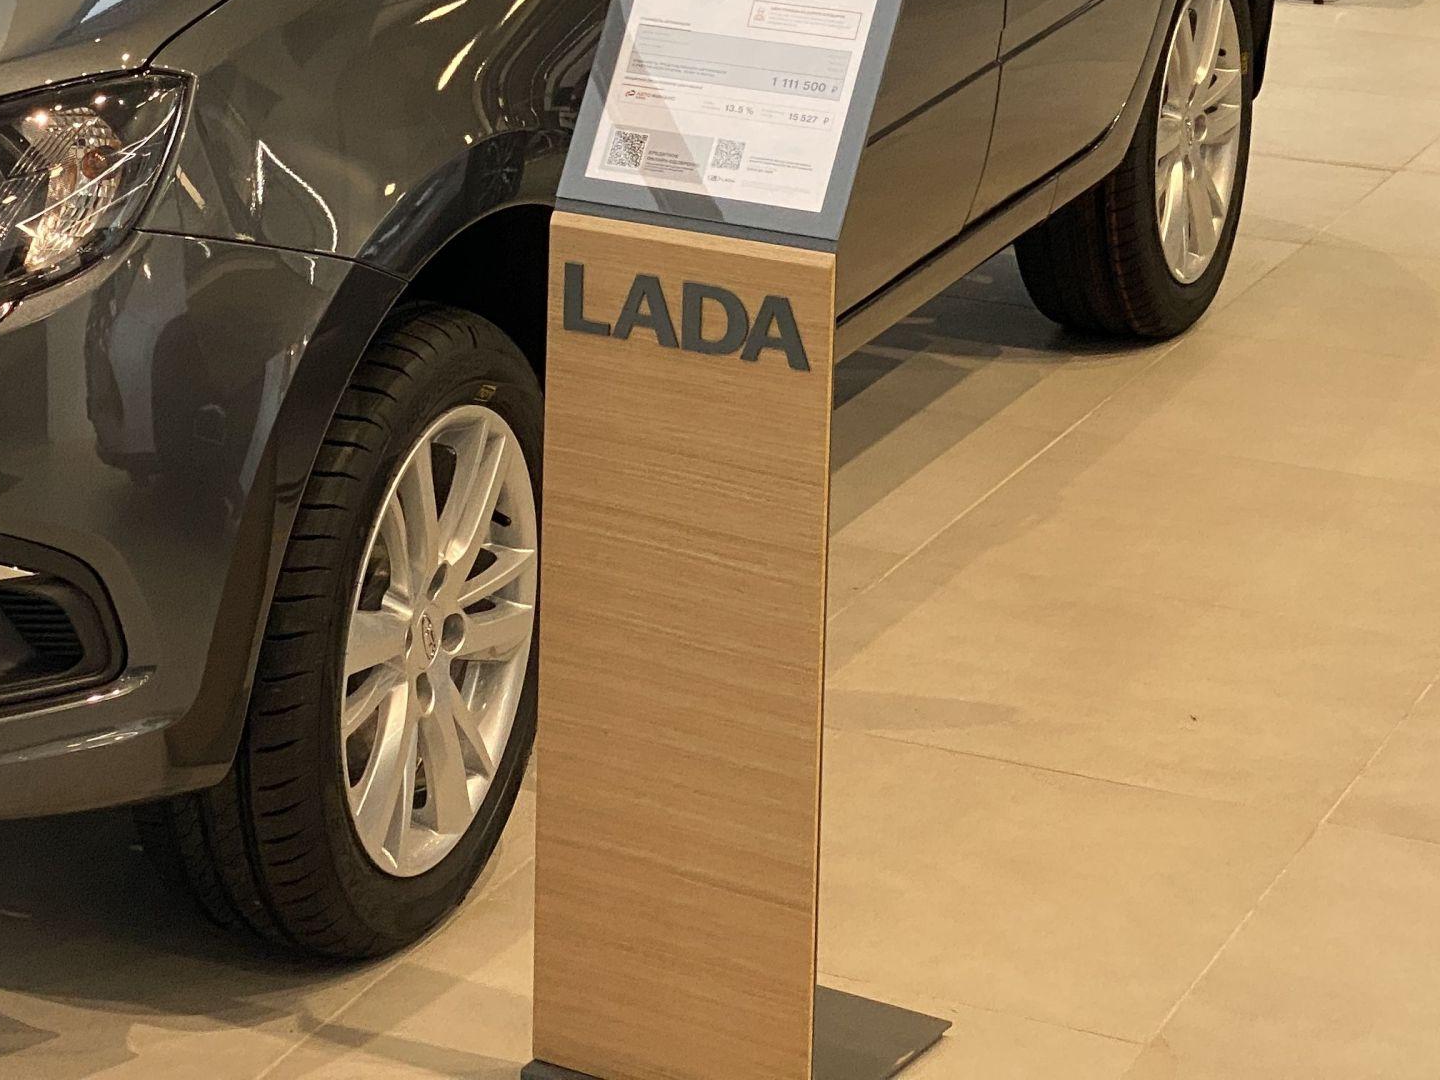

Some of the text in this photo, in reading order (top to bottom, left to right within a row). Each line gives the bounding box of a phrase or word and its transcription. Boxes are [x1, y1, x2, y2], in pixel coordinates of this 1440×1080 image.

[782, 79, 799, 89] 111
[802, 81, 827, 93] 500
[563, 261, 811, 372] LADA
